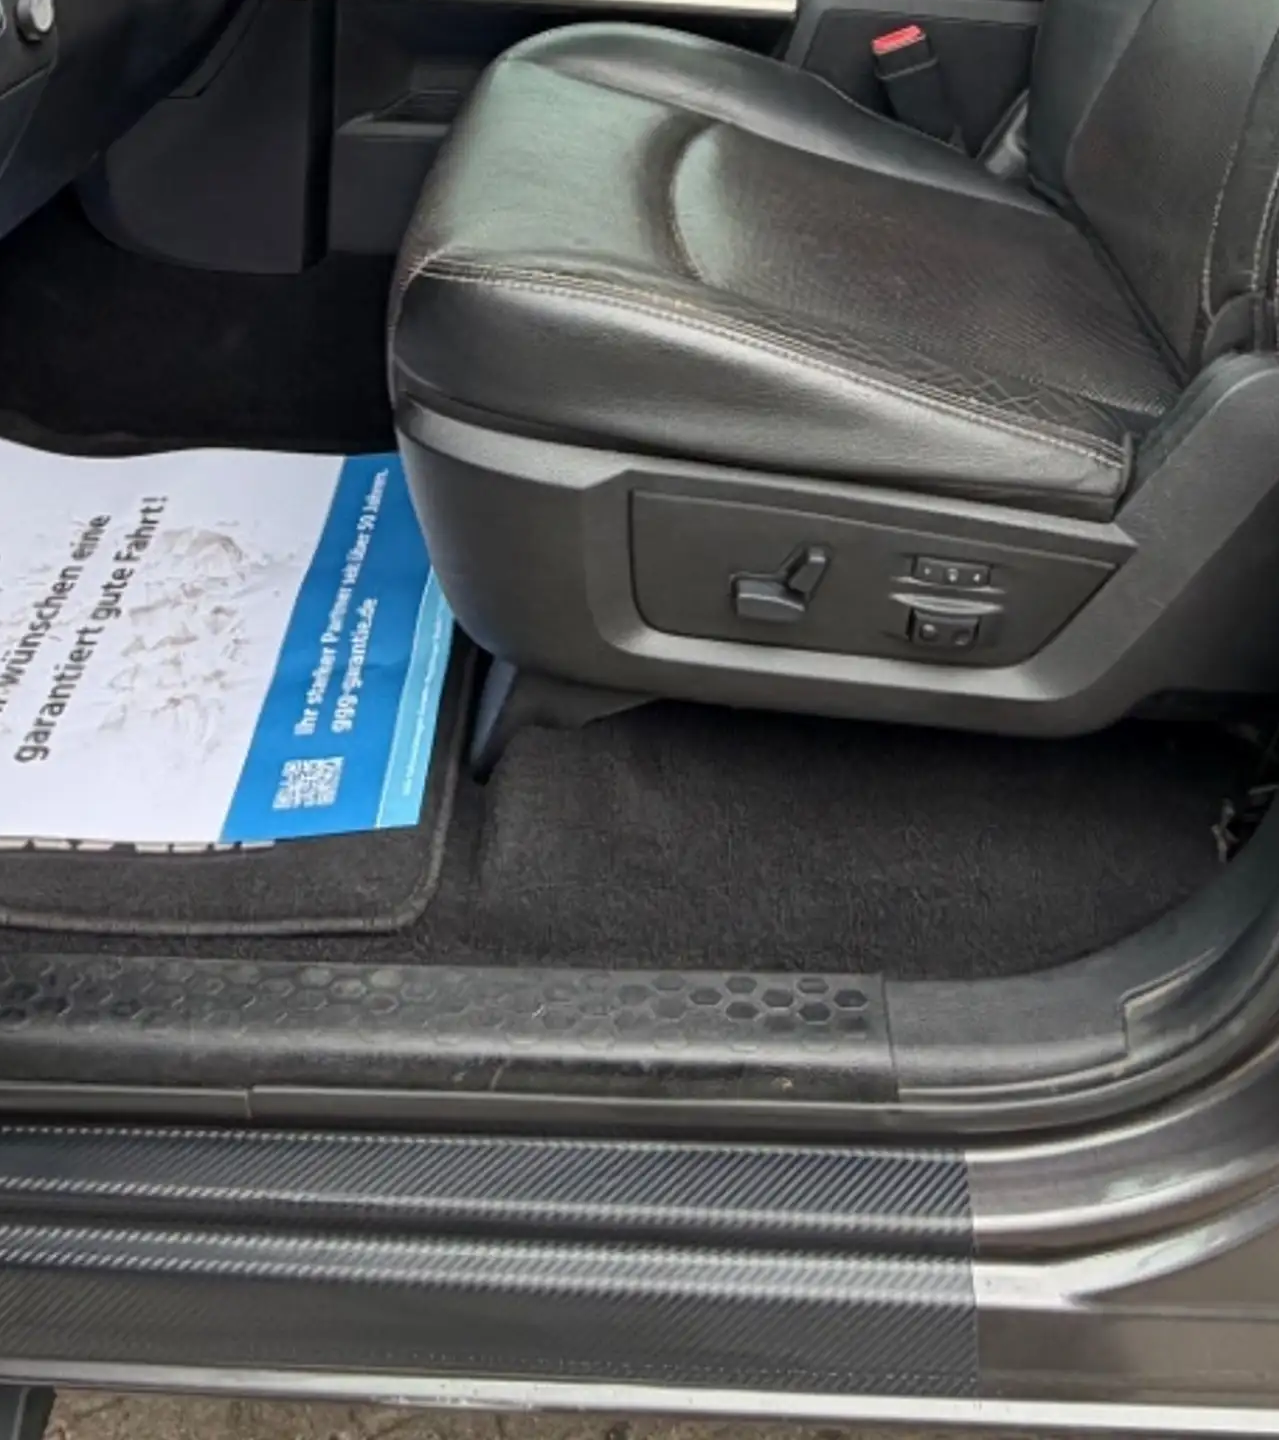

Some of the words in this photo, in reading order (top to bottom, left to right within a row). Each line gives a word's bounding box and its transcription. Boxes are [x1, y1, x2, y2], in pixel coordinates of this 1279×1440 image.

[70, 515, 112, 561] eine
[13, 625, 105, 763] garantiert
[90, 567, 136, 622] gute
[113, 495, 169, 563] Fahrt!
[294, 708, 318, 736] Ihr
